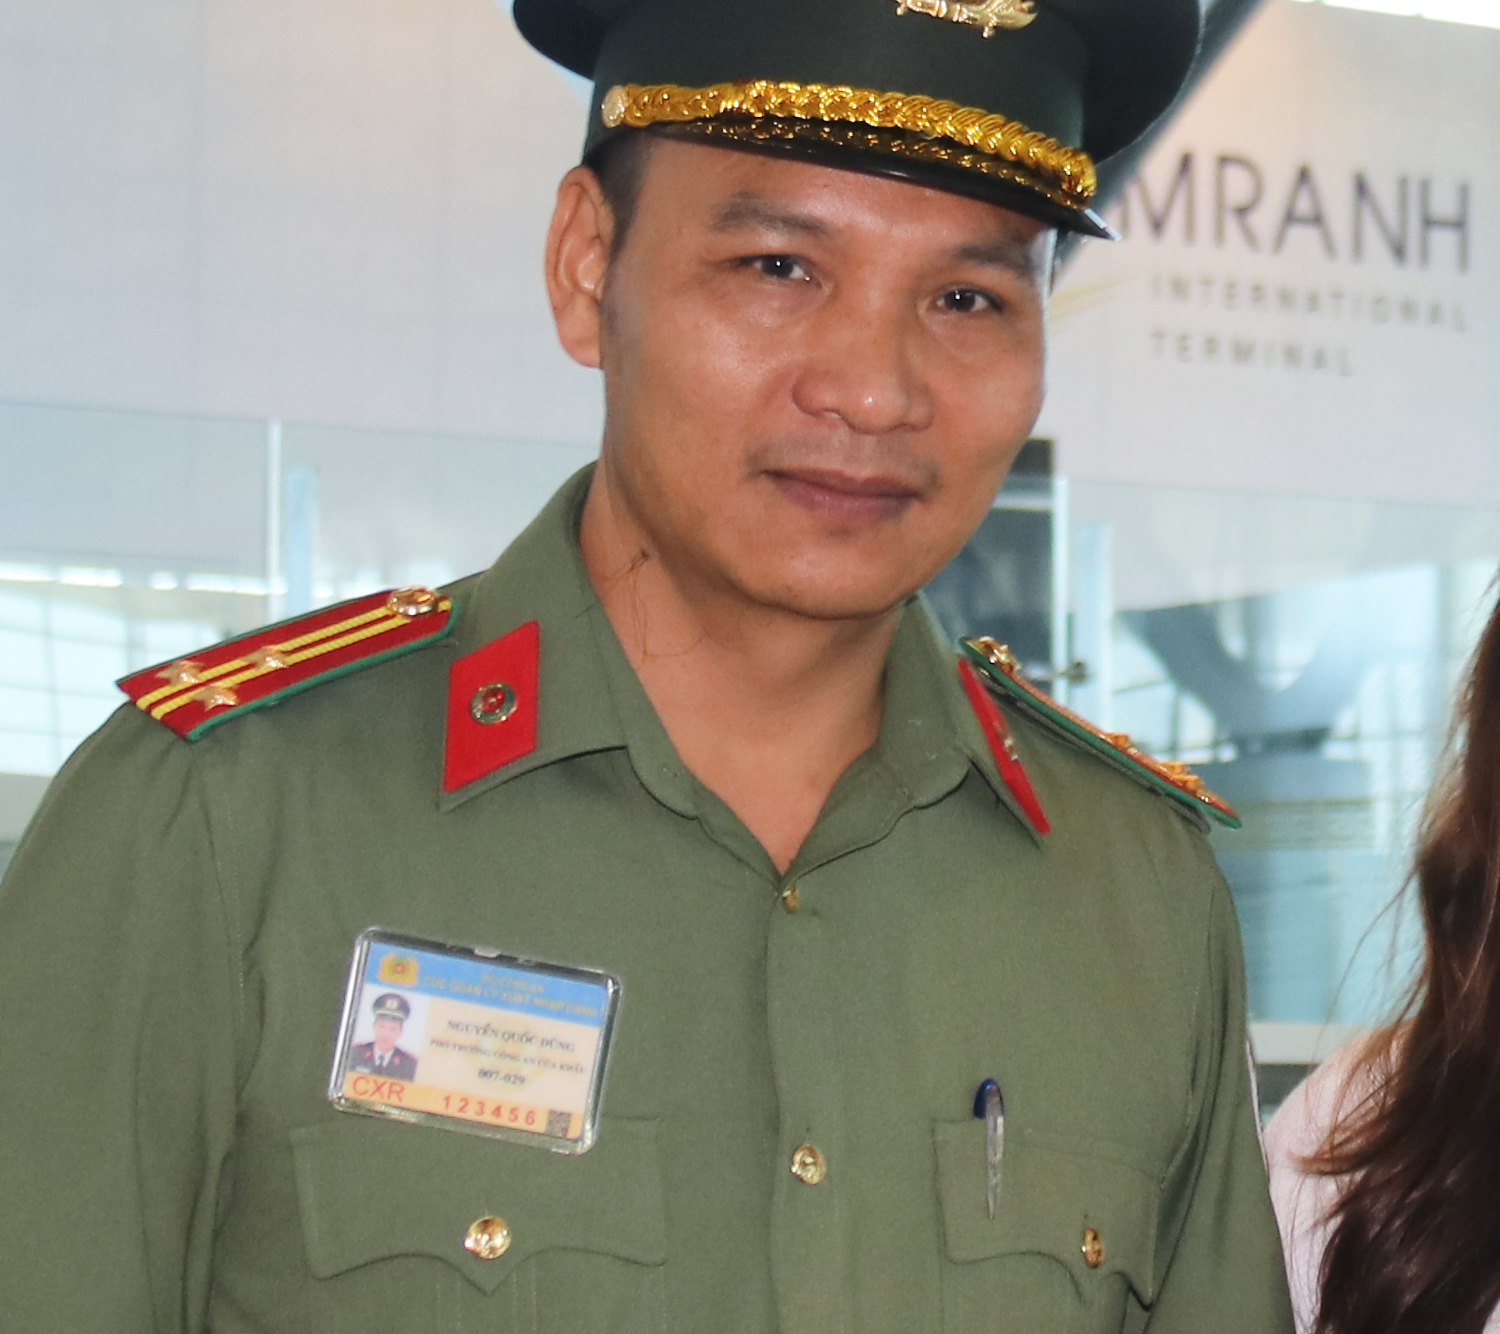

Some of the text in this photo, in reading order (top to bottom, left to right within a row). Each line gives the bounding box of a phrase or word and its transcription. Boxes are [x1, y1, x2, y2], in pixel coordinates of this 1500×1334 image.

[1149, 272, 1468, 336] INTERNATIONAL
[1150, 323, 1354, 379] TERMINAL
[351, 1075, 405, 1103] CXR
[477, 1067, 526, 1086] 007-029
